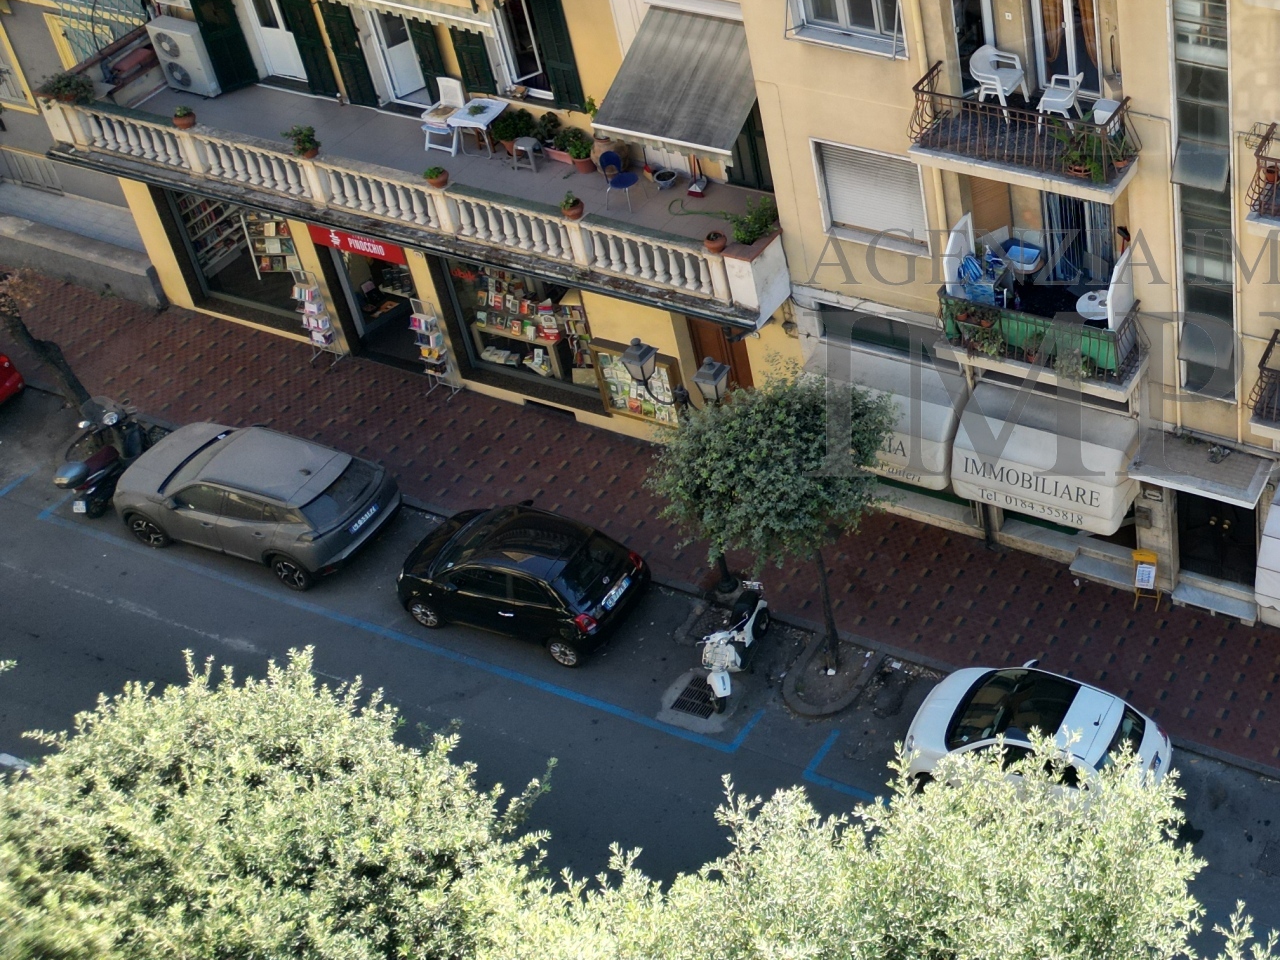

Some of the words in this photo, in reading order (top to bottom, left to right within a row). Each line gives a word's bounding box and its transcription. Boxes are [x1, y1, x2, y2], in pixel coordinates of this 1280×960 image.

[348, 238, 385, 256] PINOCCHIO
[963, 456, 1101, 508] IMMOBILIARE
[1005, 495, 1083, 525] 0184.355818
